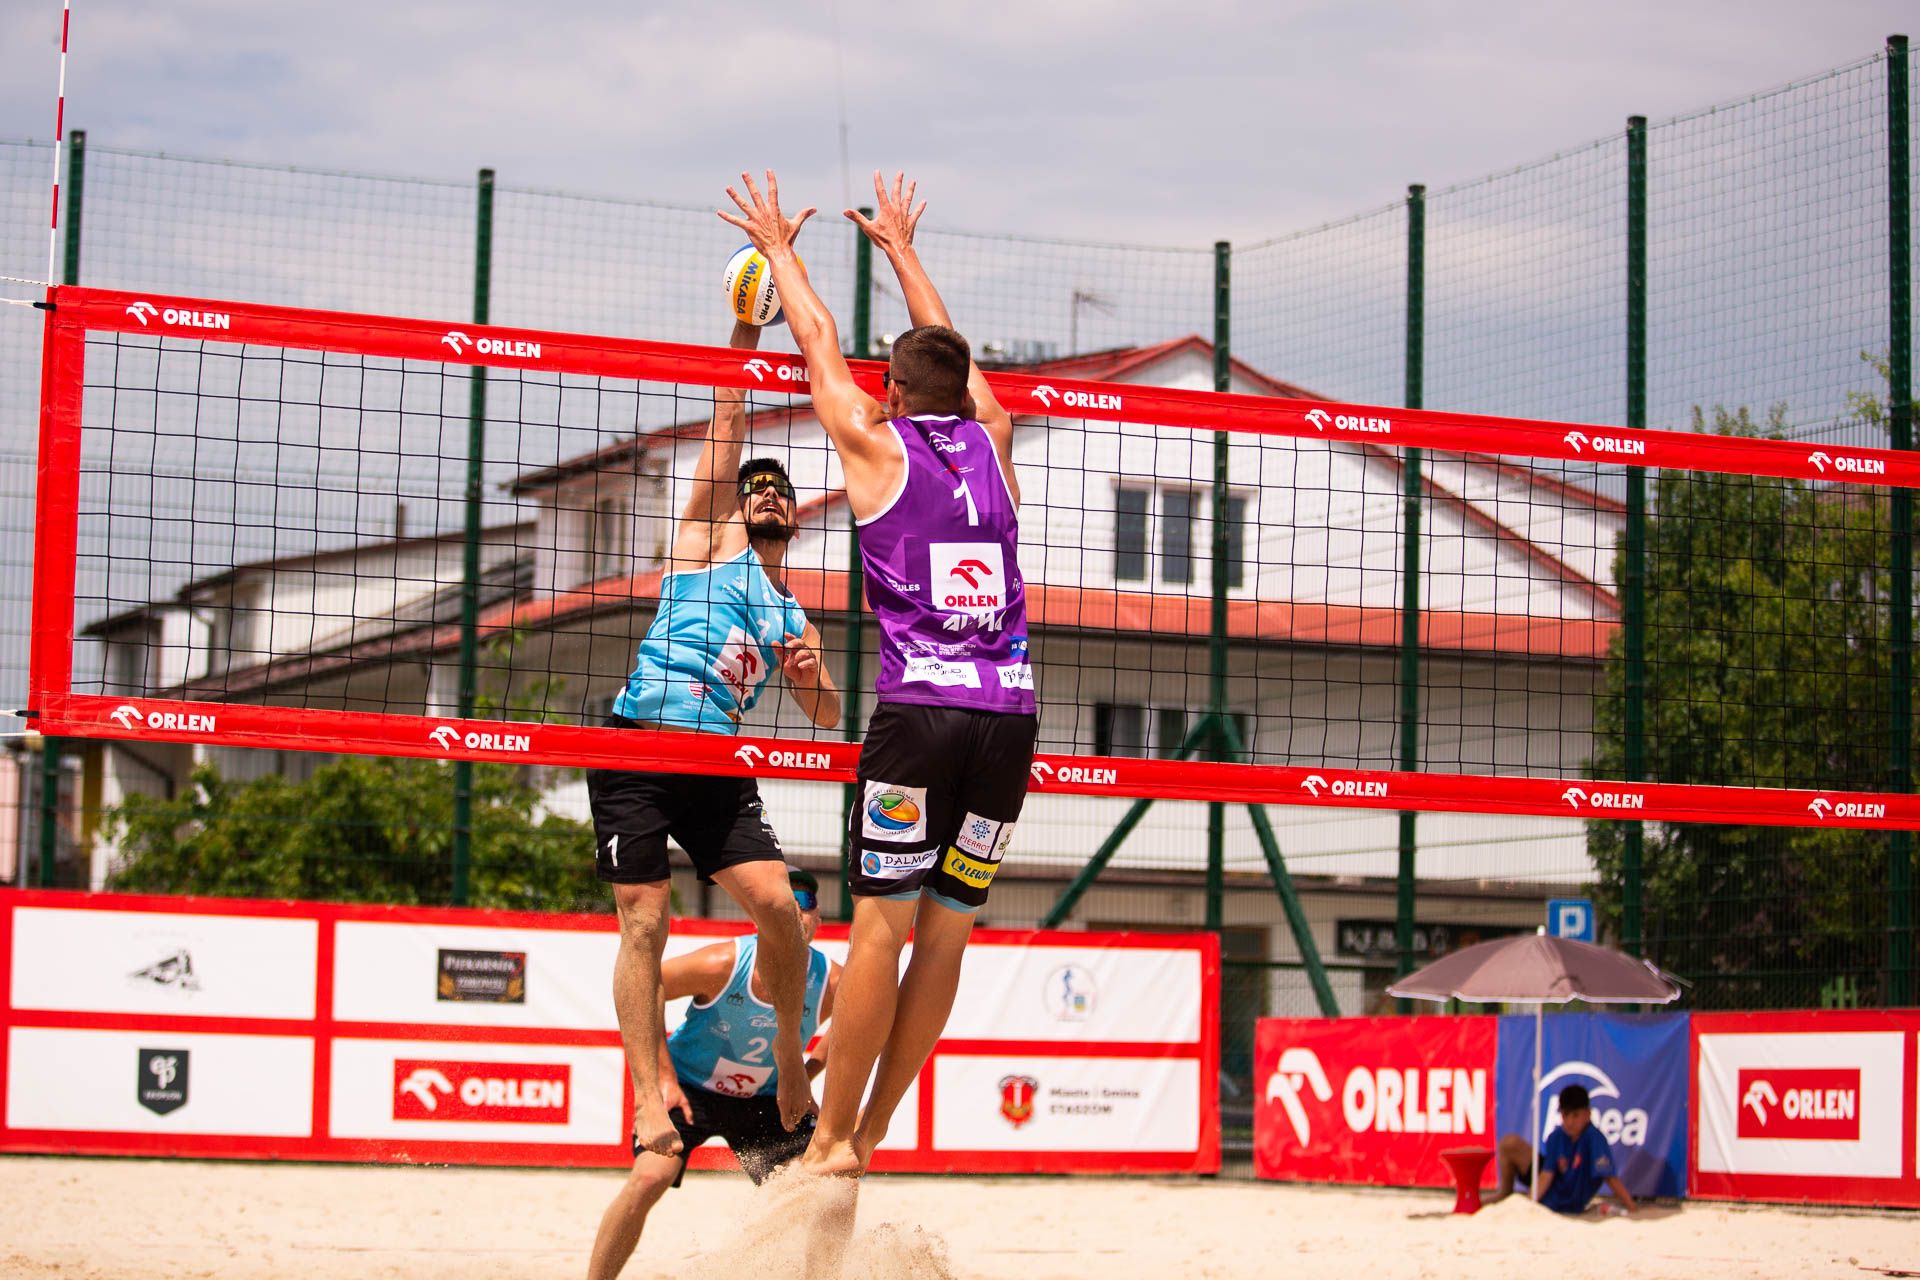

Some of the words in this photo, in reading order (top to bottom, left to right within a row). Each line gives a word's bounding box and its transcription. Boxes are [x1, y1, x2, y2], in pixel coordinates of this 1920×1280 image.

[163, 309, 229, 329] ORLEN
[759, 304, 770, 321] PRO
[477, 339, 540, 358] ORLEN
[1064, 392, 1121, 410] ORLEN
[1335, 416, 1390, 433] ORLEN
[1593, 437, 1645, 454] ORLEN
[1835, 457, 1885, 473] ORLEN
[953, 477, 979, 526] 1
[945, 595, 998, 607] ORLEN
[148, 712, 215, 731] ORLEN
[465, 733, 529, 751] ORLEN
[769, 751, 830, 769] ORLEN
[1058, 767, 1116, 784] ORLEN
[1332, 781, 1388, 797] ORLEN
[1591, 793, 1643, 809] ORLEN
[1835, 803, 1885, 818] ORLEN
[607, 834, 618, 867] 1
[960, 834, 991, 852] PIERROT
[1559, 906, 1586, 938] P
[741, 1037, 768, 1063] 2
[461, 1078, 564, 1108] ORLEN
[1343, 1066, 1487, 1134] ORLEN
[1783, 1089, 1855, 1119] ORLEN
